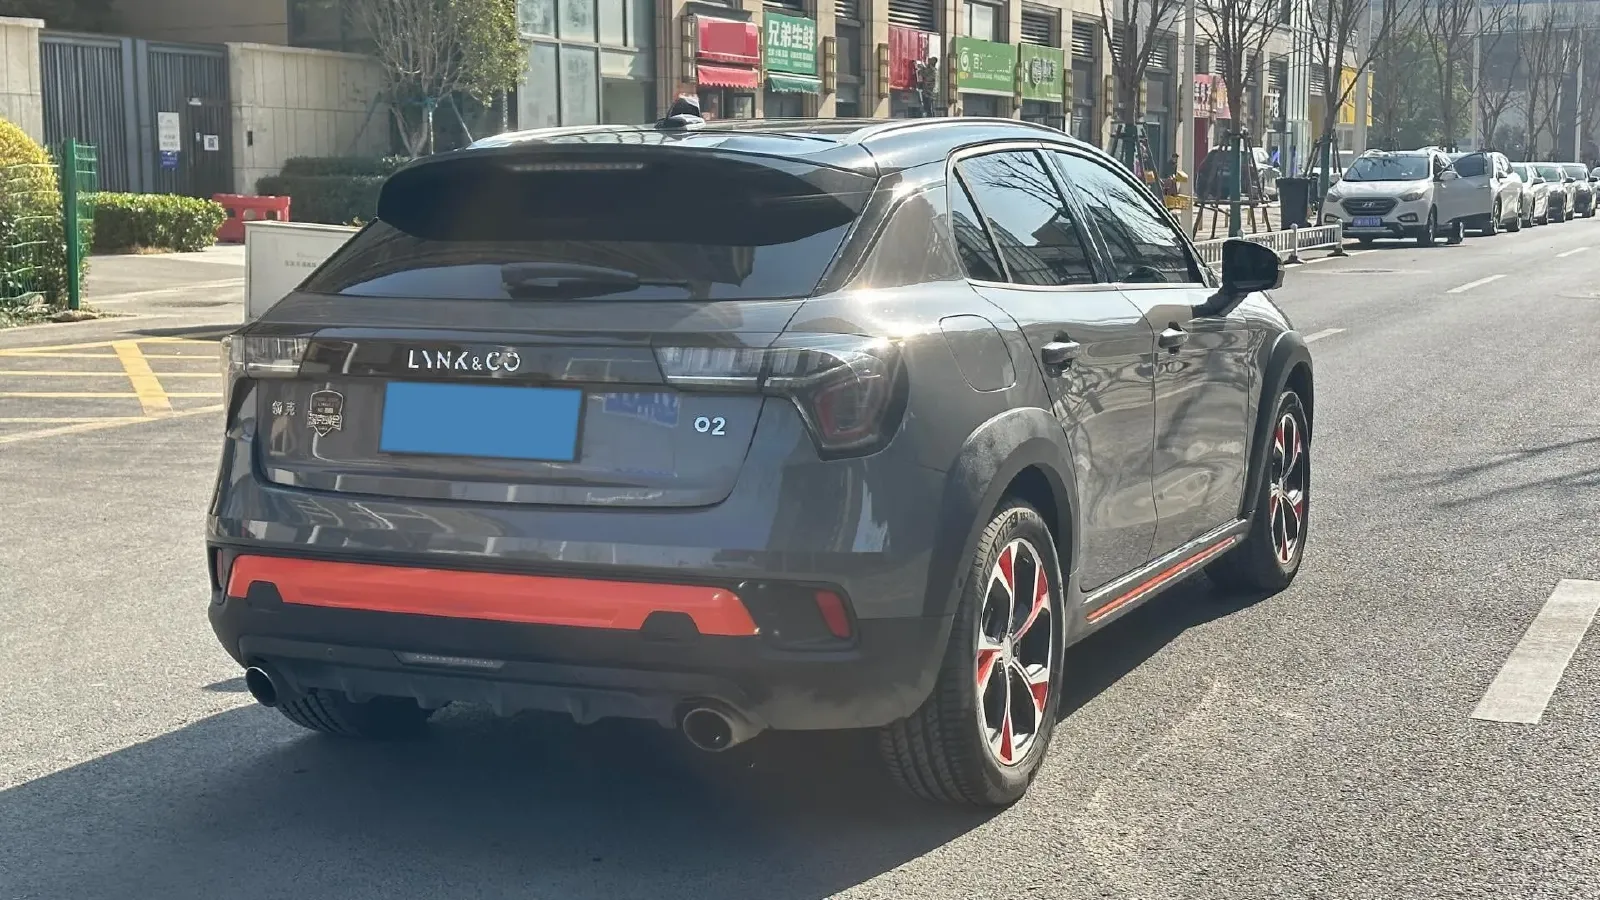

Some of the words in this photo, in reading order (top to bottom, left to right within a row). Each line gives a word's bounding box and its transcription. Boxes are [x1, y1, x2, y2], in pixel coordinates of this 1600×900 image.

[768, 19, 814, 52] 兄弟生鲜
[407, 349, 521, 372] LYNK&CO
